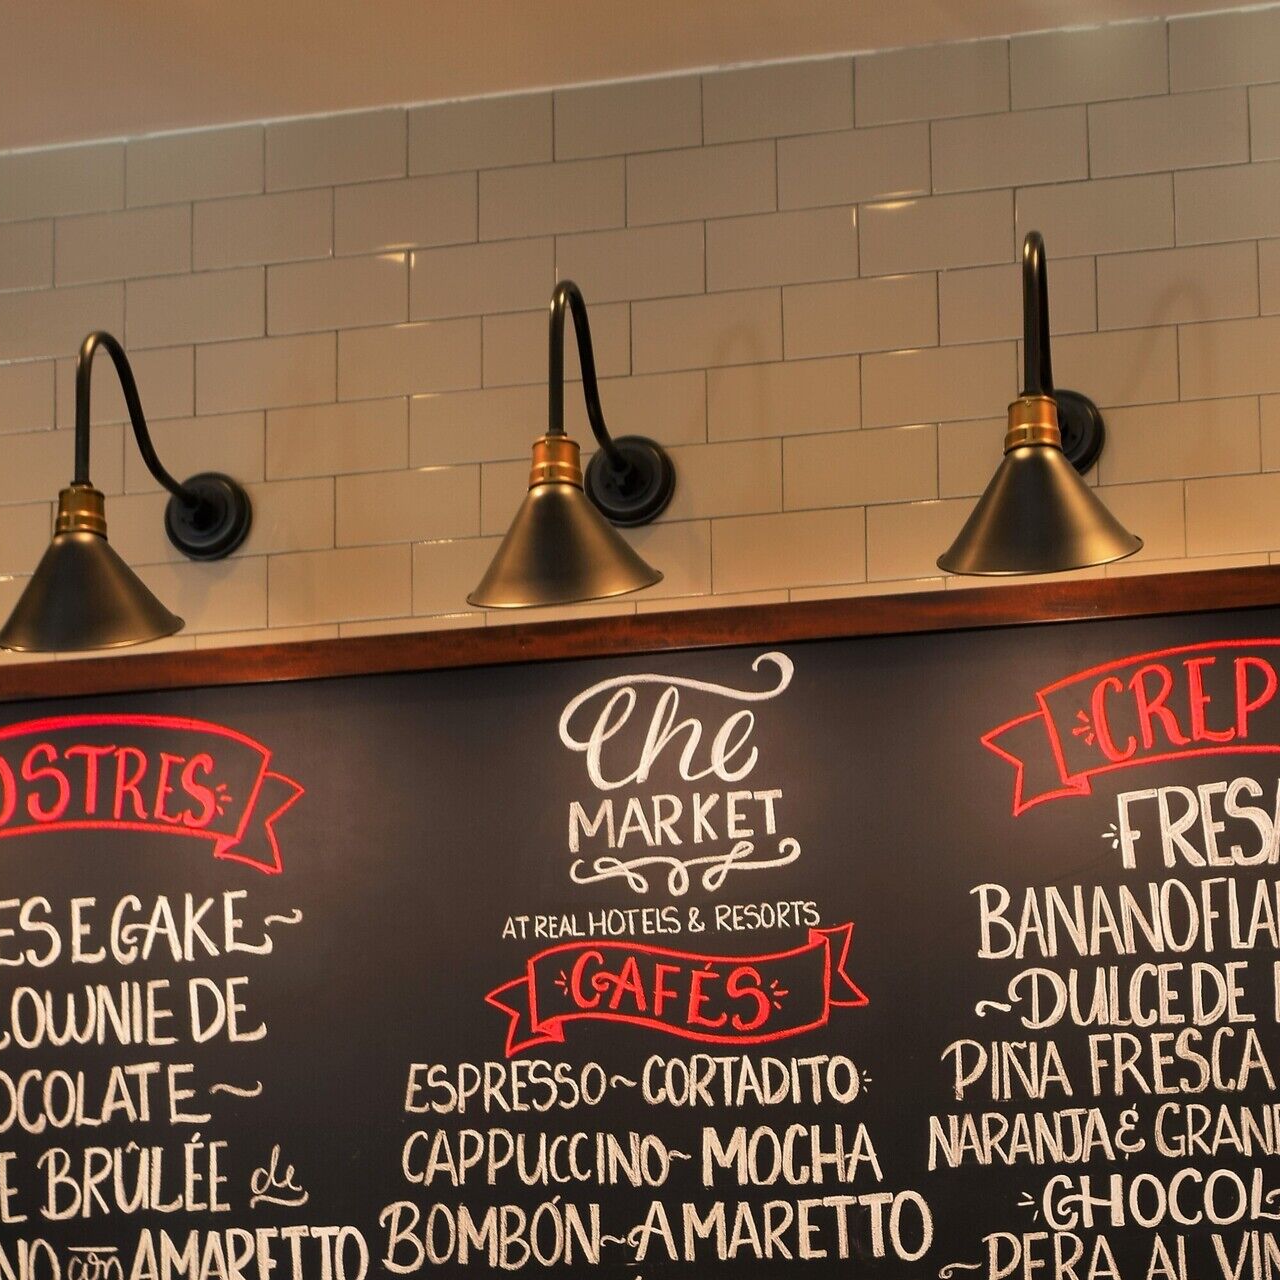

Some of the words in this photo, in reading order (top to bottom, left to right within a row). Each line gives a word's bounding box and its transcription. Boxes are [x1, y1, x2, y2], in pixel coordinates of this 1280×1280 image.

[569, 789, 782, 852] MARKET
[502, 914, 528, 939] AT
[534, 912, 584, 938] REAL
[589, 906, 682, 934] HOTELS
[689, 906, 705, 931] &
[716, 902, 820, 931] RESORTS
[971, 878, 1199, 959] BANANO
[189, 977, 266, 1043] DE
[570, 950, 771, 1030] CAFÉS
[1008, 961, 1181, 1029] DULCE
[1192, 961, 1255, 1025] DE
[404, 1061, 606, 1112] ESPRESSO
[642, 1055, 859, 1108] CORTADITO
[941, 1034, 1072, 1101] PIÑA
[1089, 1028, 1276, 1098] FRESCA
[402, 1127, 670, 1188] CAPPUCCINO
[703, 1124, 882, 1188] MOCHA
[928, 1107, 1114, 1172] NARANJA
[38, 1133, 230, 1219] BRÛLÉE
[251, 1145, 309, 1192] de
[379, 1197, 600, 1272] BOMBÓN
[623, 1191, 934, 1262] AMARETTO
